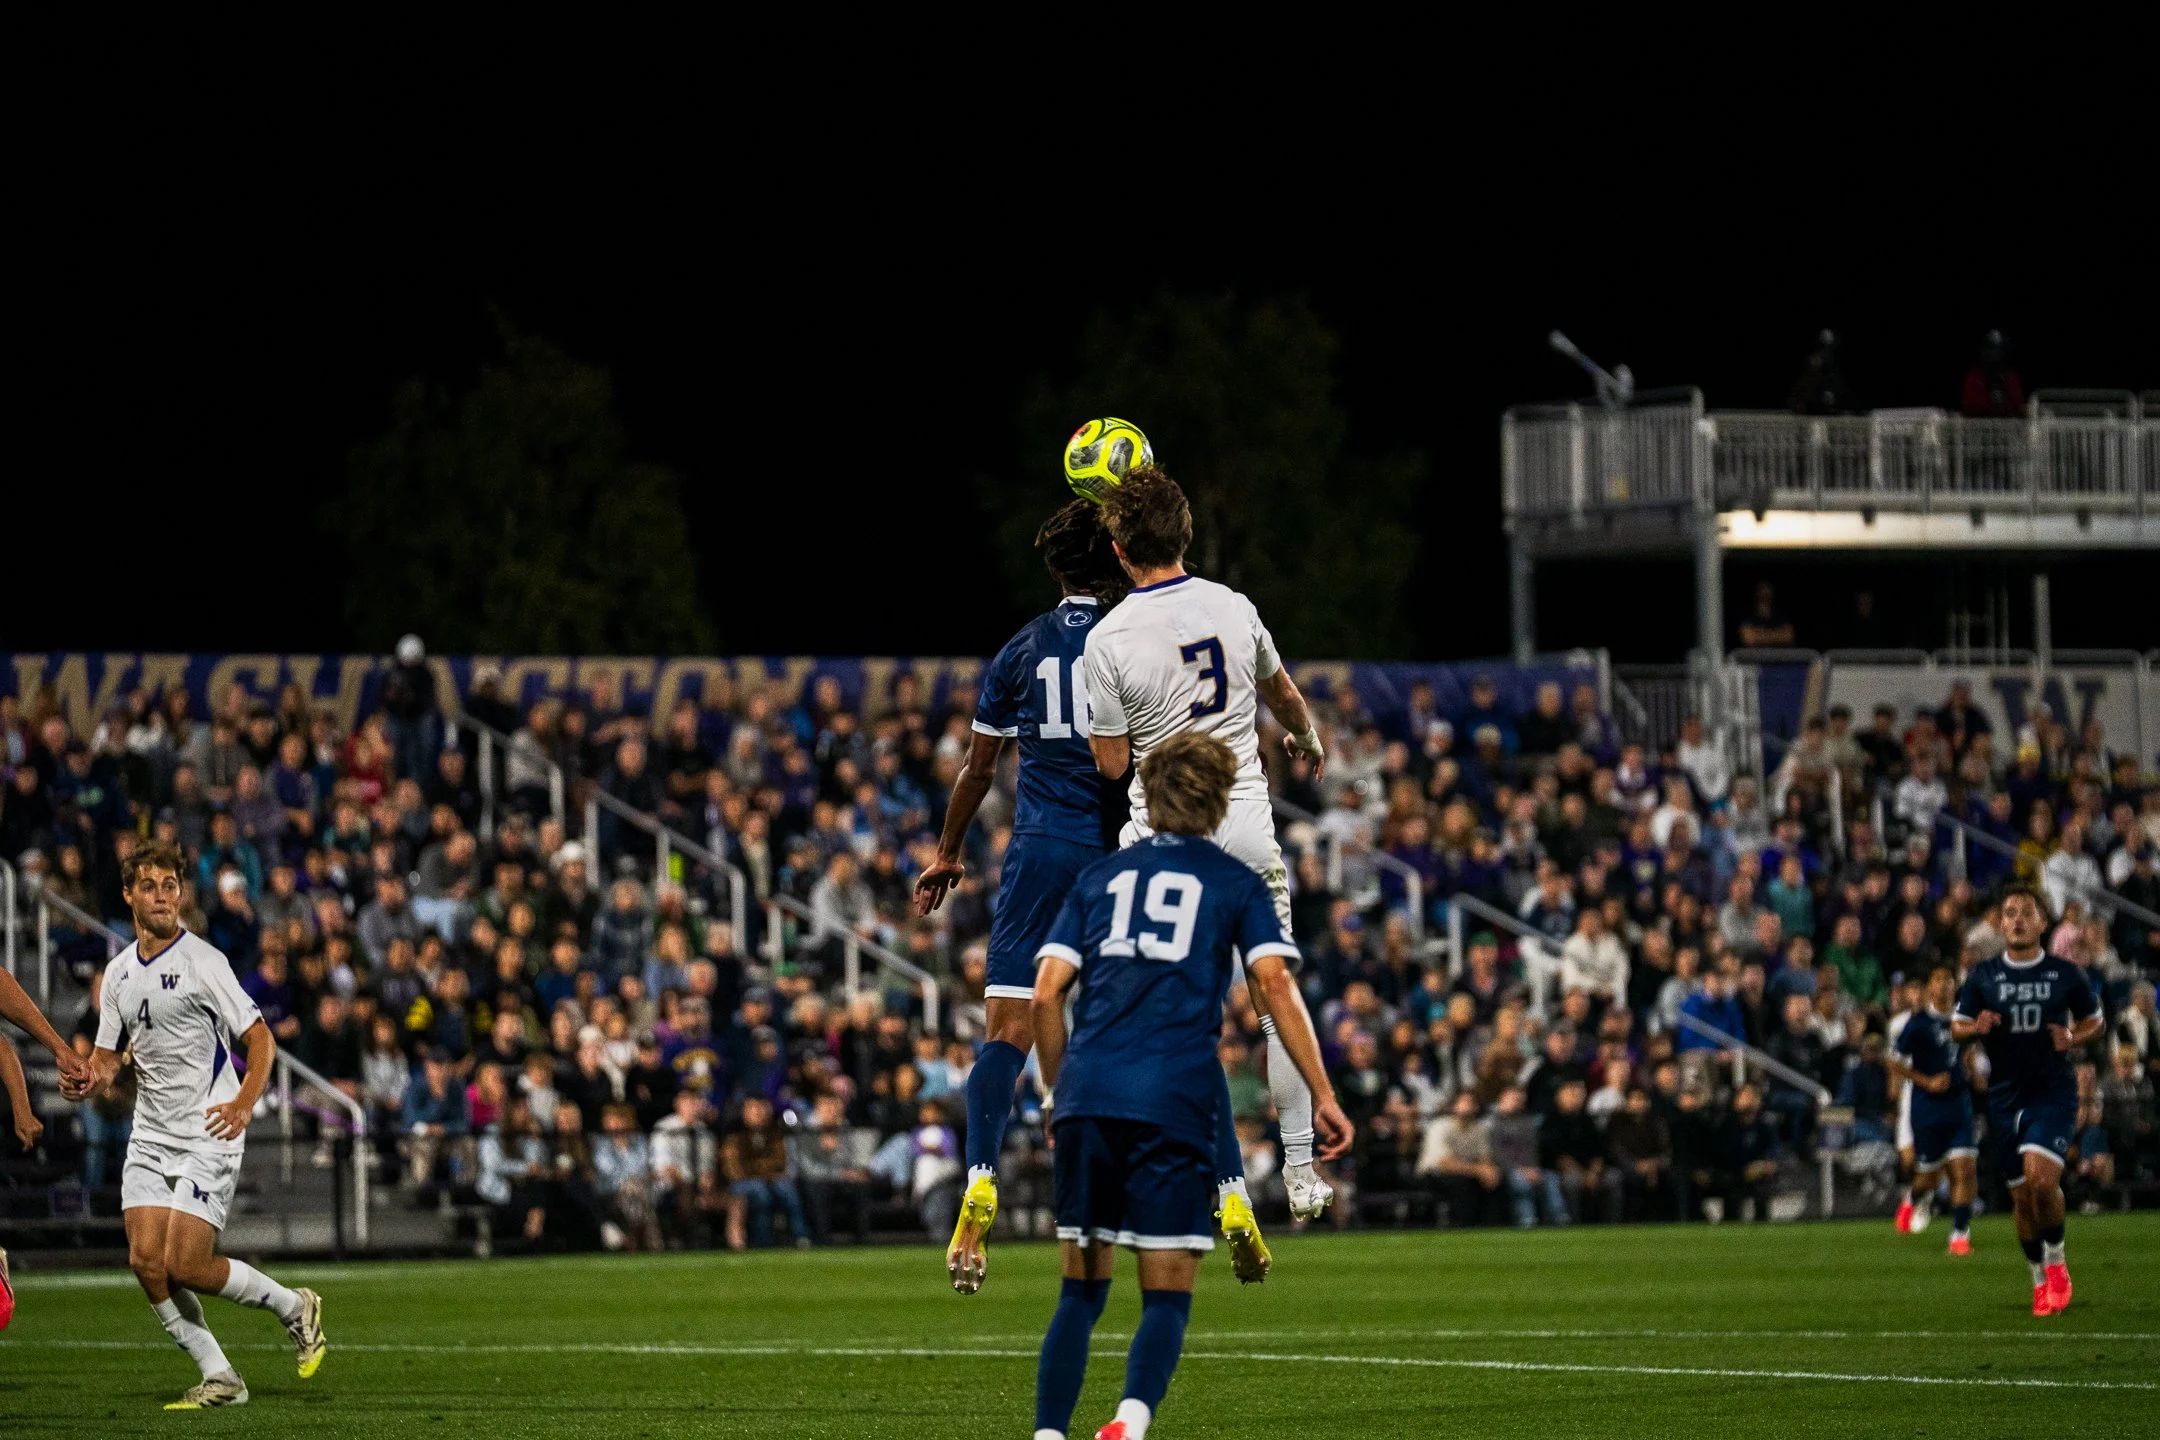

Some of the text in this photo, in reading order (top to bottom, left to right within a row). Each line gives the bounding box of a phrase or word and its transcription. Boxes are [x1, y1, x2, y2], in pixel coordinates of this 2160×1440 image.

[1179, 634, 1229, 719] 3
[1099, 869, 1203, 963] 19
[160, 973, 181, 990] W
[1999, 981, 2051, 1001] PSU
[137, 998, 153, 1030] 4
[2010, 1003, 2042, 1034] 10
